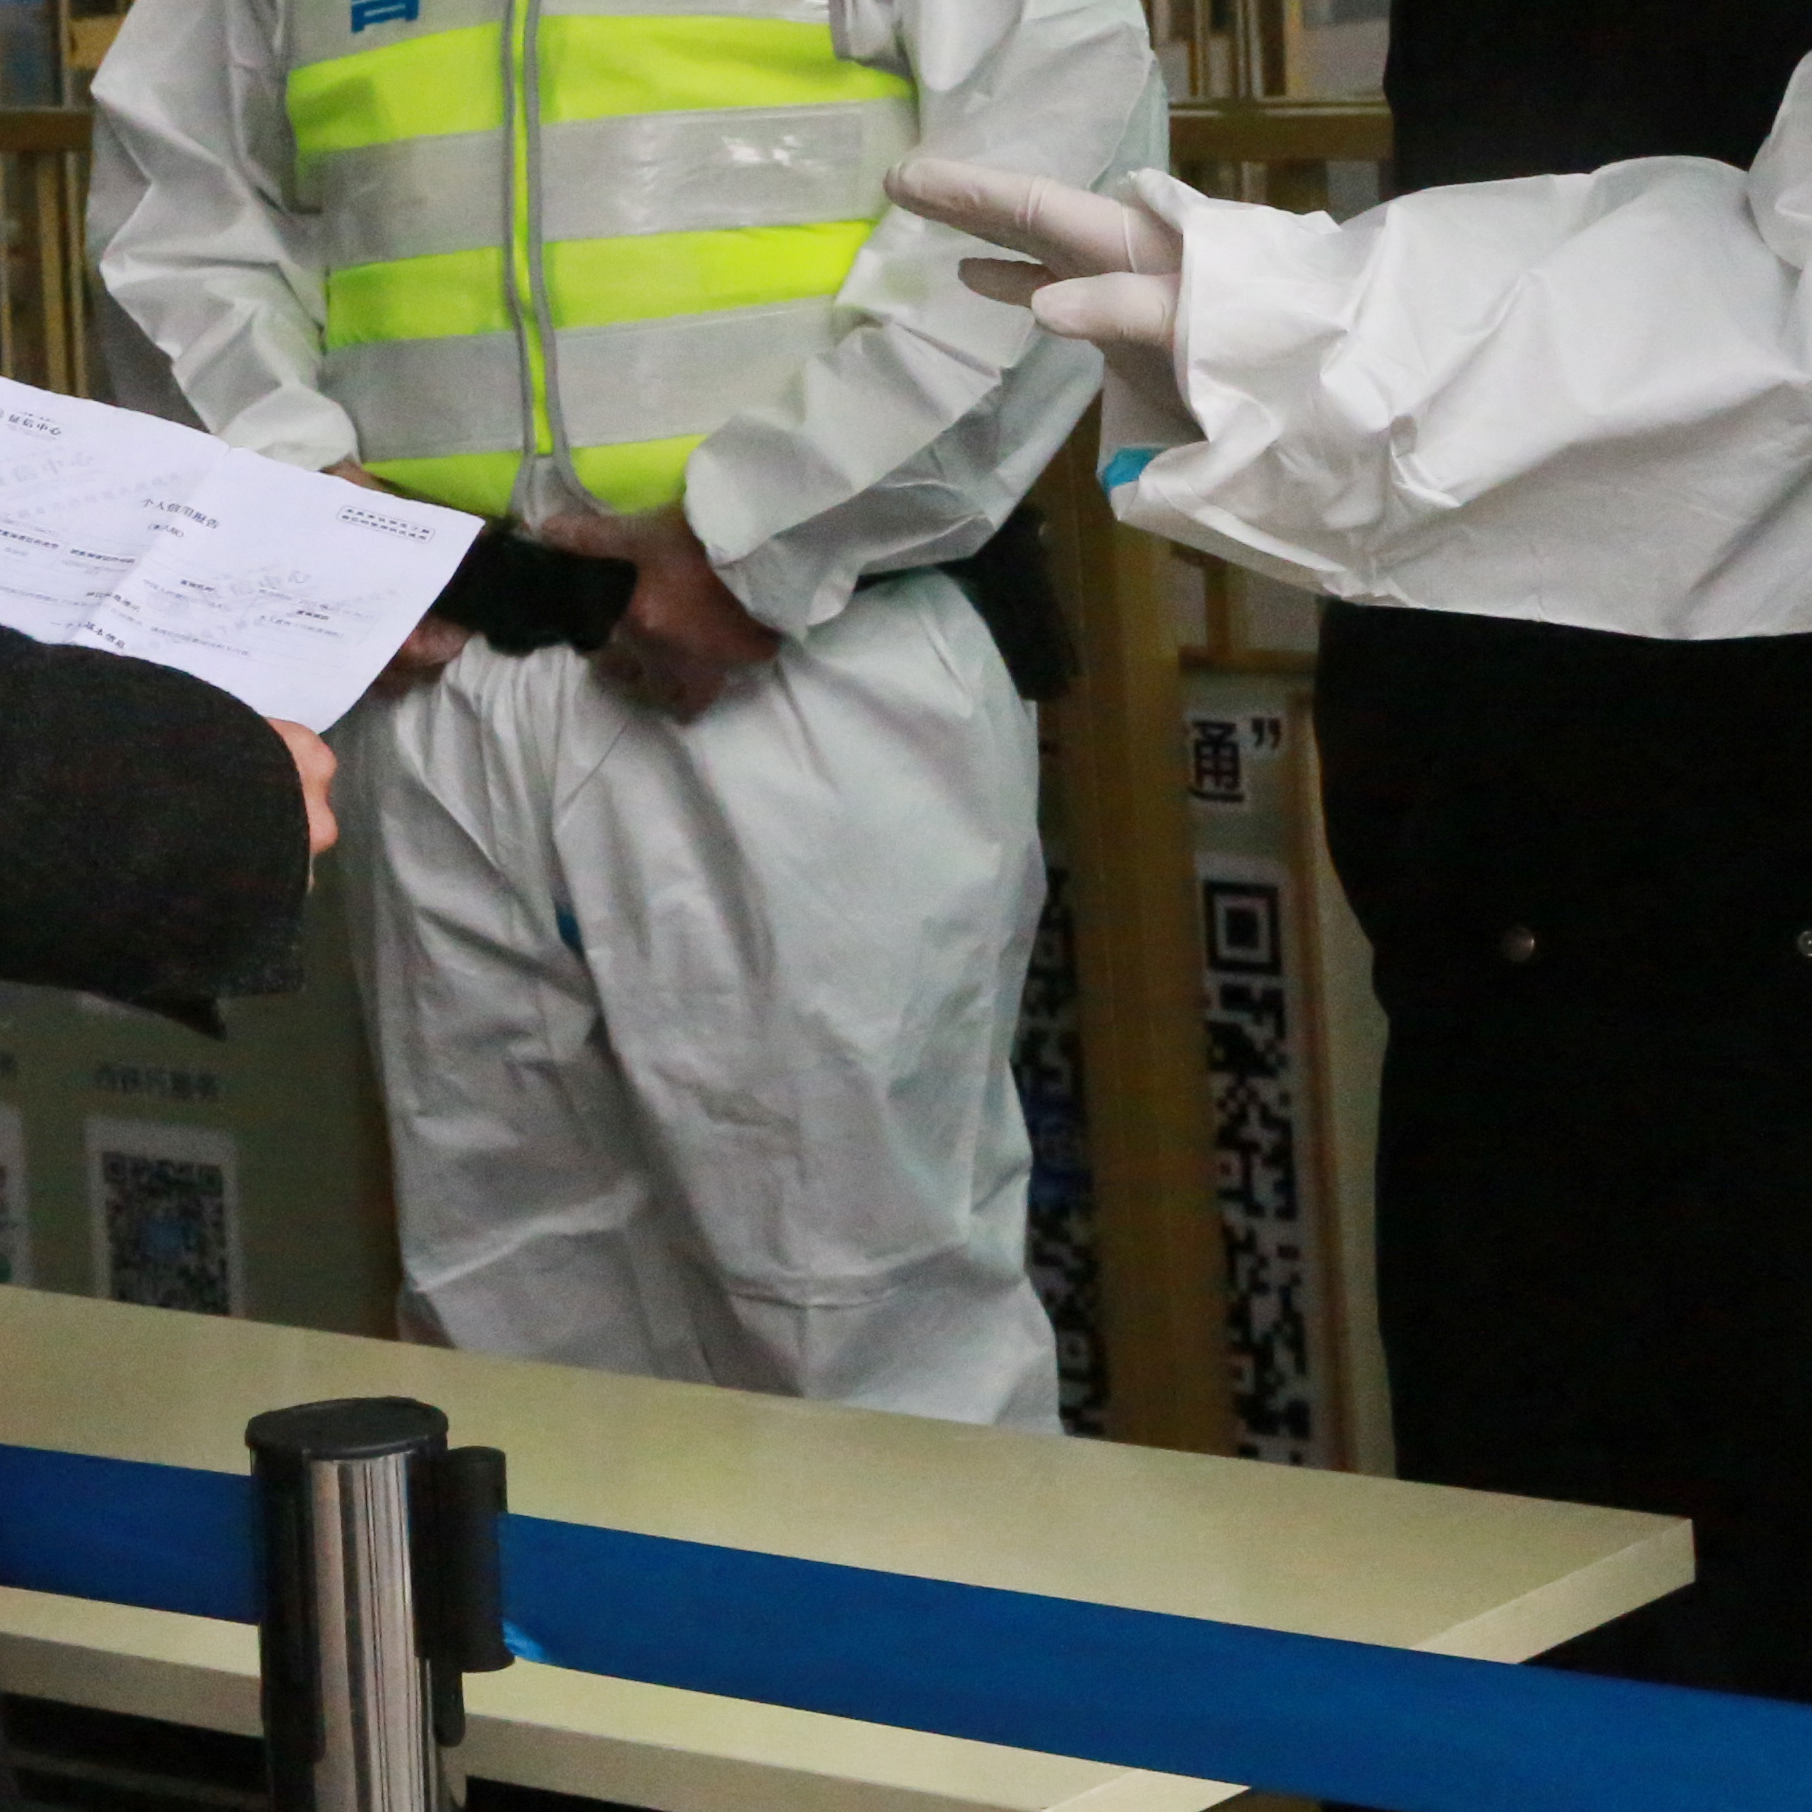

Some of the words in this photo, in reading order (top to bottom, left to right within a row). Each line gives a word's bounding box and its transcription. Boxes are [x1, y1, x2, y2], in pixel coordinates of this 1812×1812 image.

[142, 498, 219, 529] 个人信用报告
